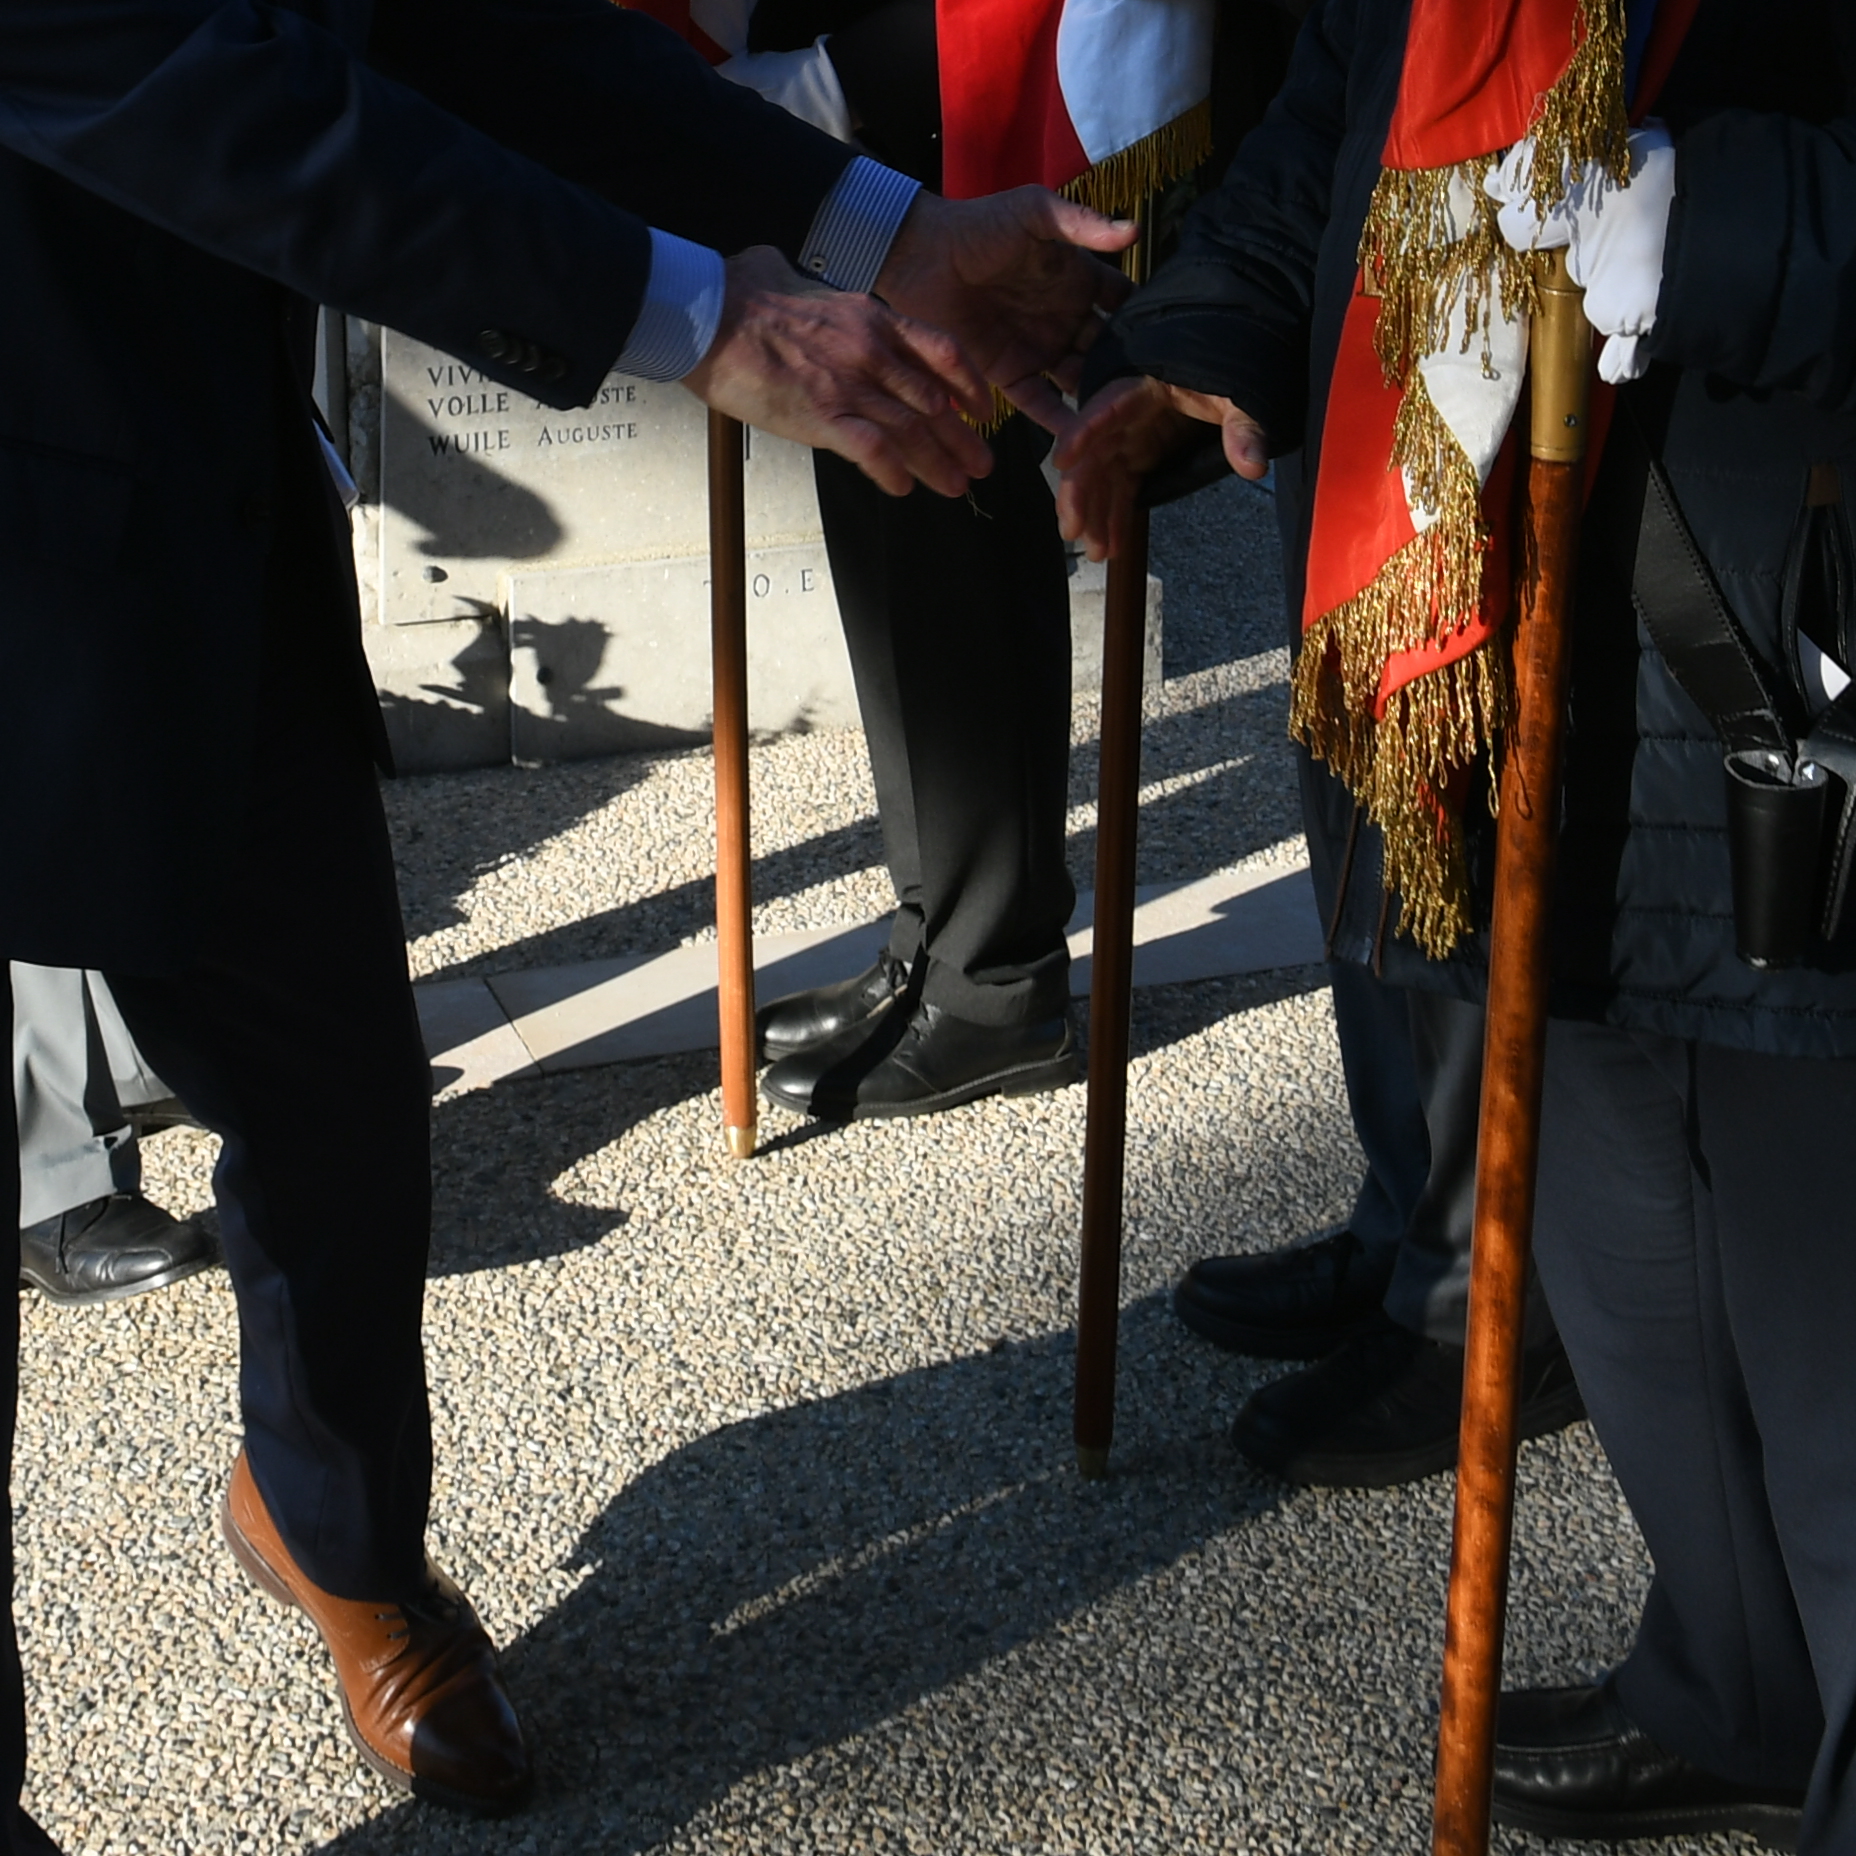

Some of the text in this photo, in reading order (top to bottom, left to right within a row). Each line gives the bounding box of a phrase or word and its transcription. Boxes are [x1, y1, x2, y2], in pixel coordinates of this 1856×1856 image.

[427, 391, 510, 419] VOLLE
[428, 422, 638, 457] WUILE AUGUSTE
